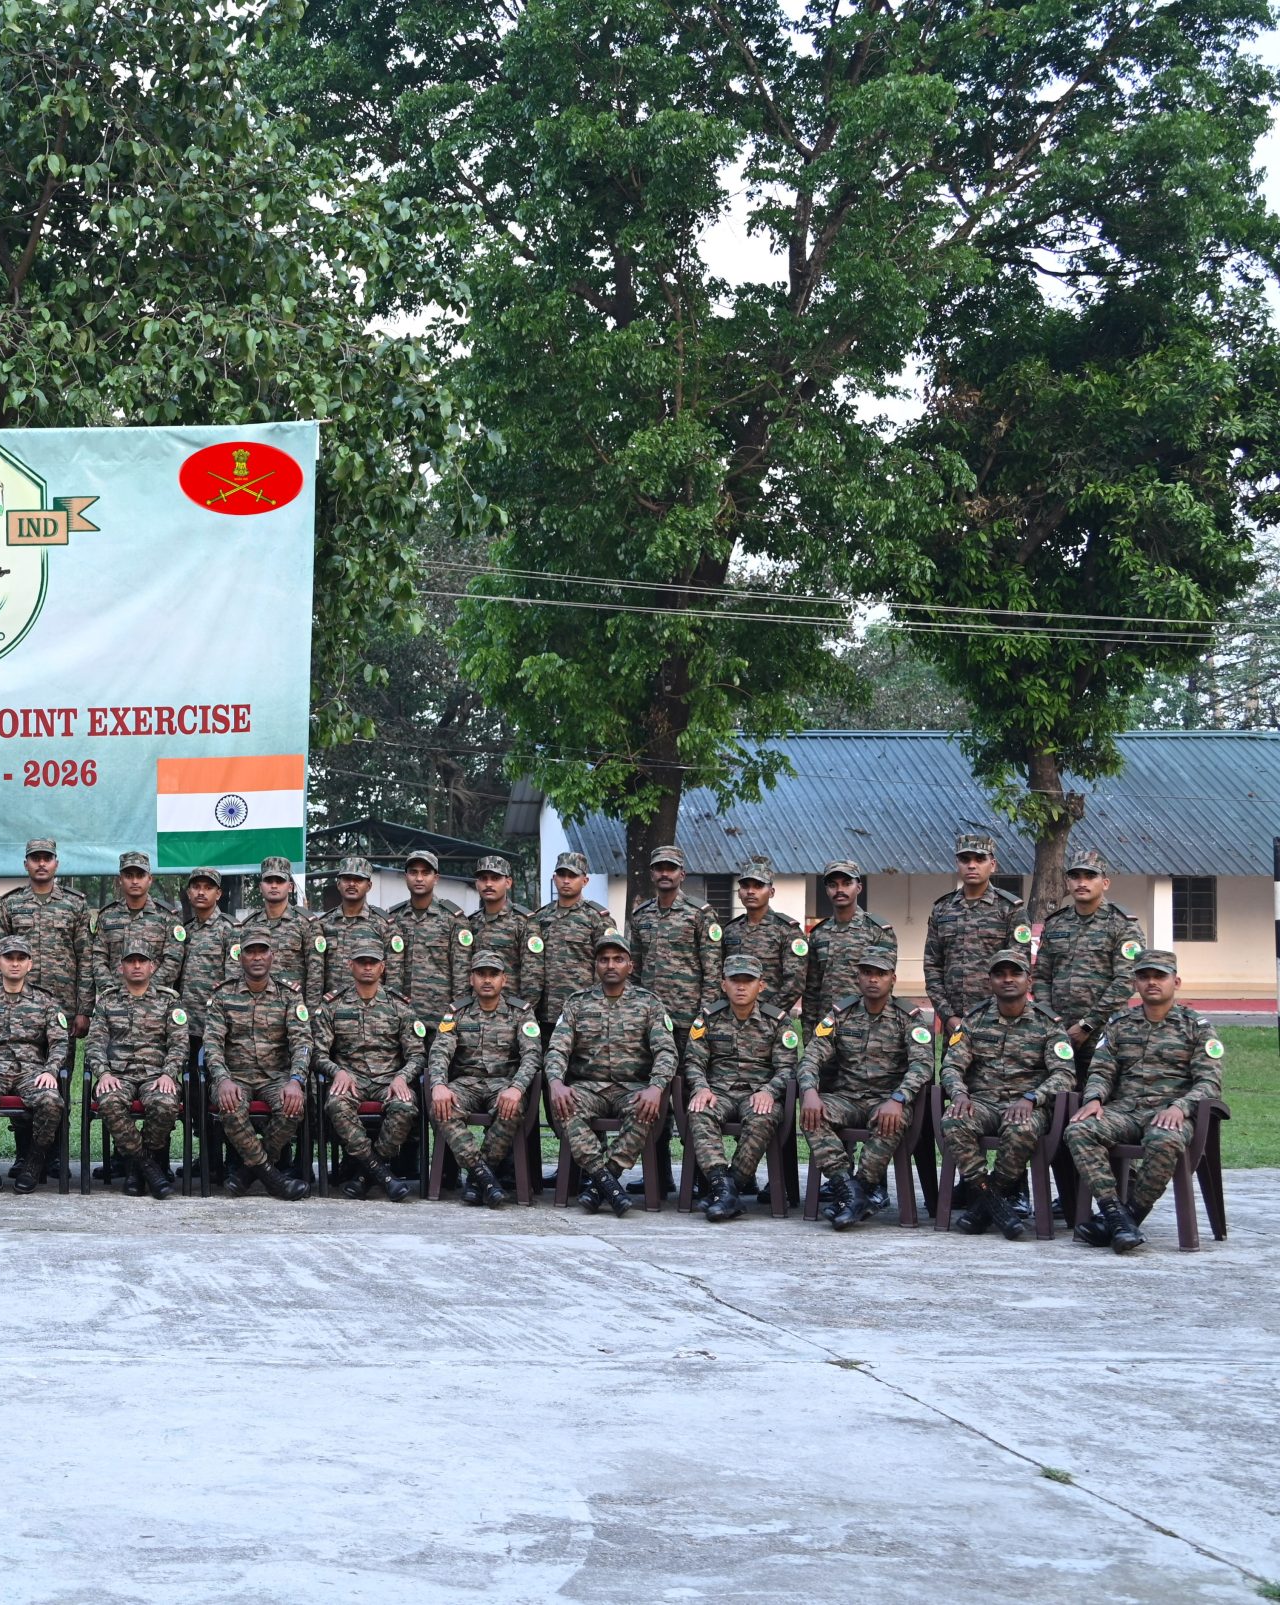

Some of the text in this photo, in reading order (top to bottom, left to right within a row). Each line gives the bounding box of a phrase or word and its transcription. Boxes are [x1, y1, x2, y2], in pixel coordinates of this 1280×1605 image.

[17, 517, 59, 538] IND
[87, 704, 251, 737] EXERCISE
[23, 759, 98, 788] 2026
